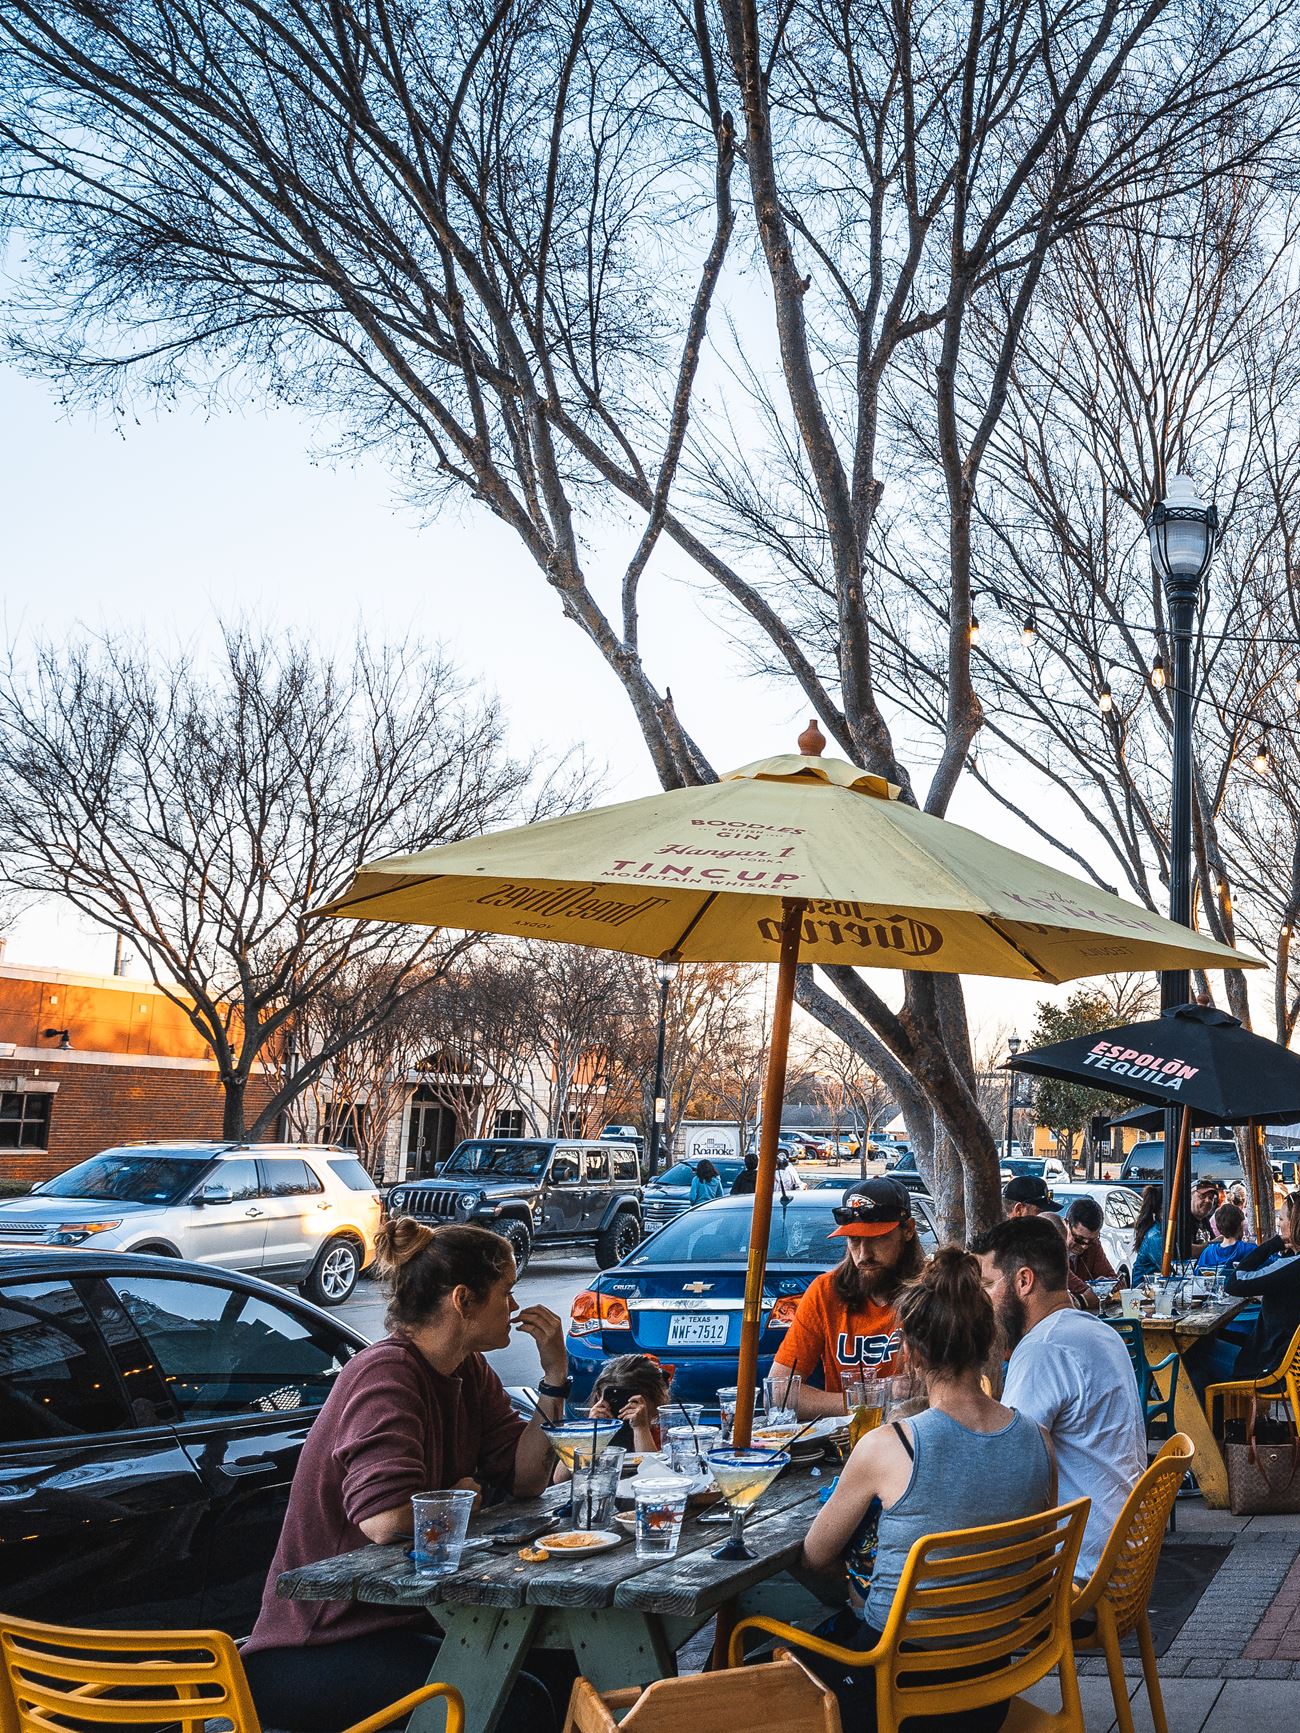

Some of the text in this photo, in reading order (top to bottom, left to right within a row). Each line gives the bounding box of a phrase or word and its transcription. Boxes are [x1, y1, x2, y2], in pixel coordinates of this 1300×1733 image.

[691, 819, 806, 835] BOODLES
[716, 832, 760, 840] GIN
[654, 843, 795, 859] Hangar 1
[612, 860, 801, 884] TINCUP
[601, 871, 793, 891] MOUNTAIN WHISKEY
[1083, 1053, 1184, 1090] TEQUILA
[693, 1143, 735, 1156] Roanoke
